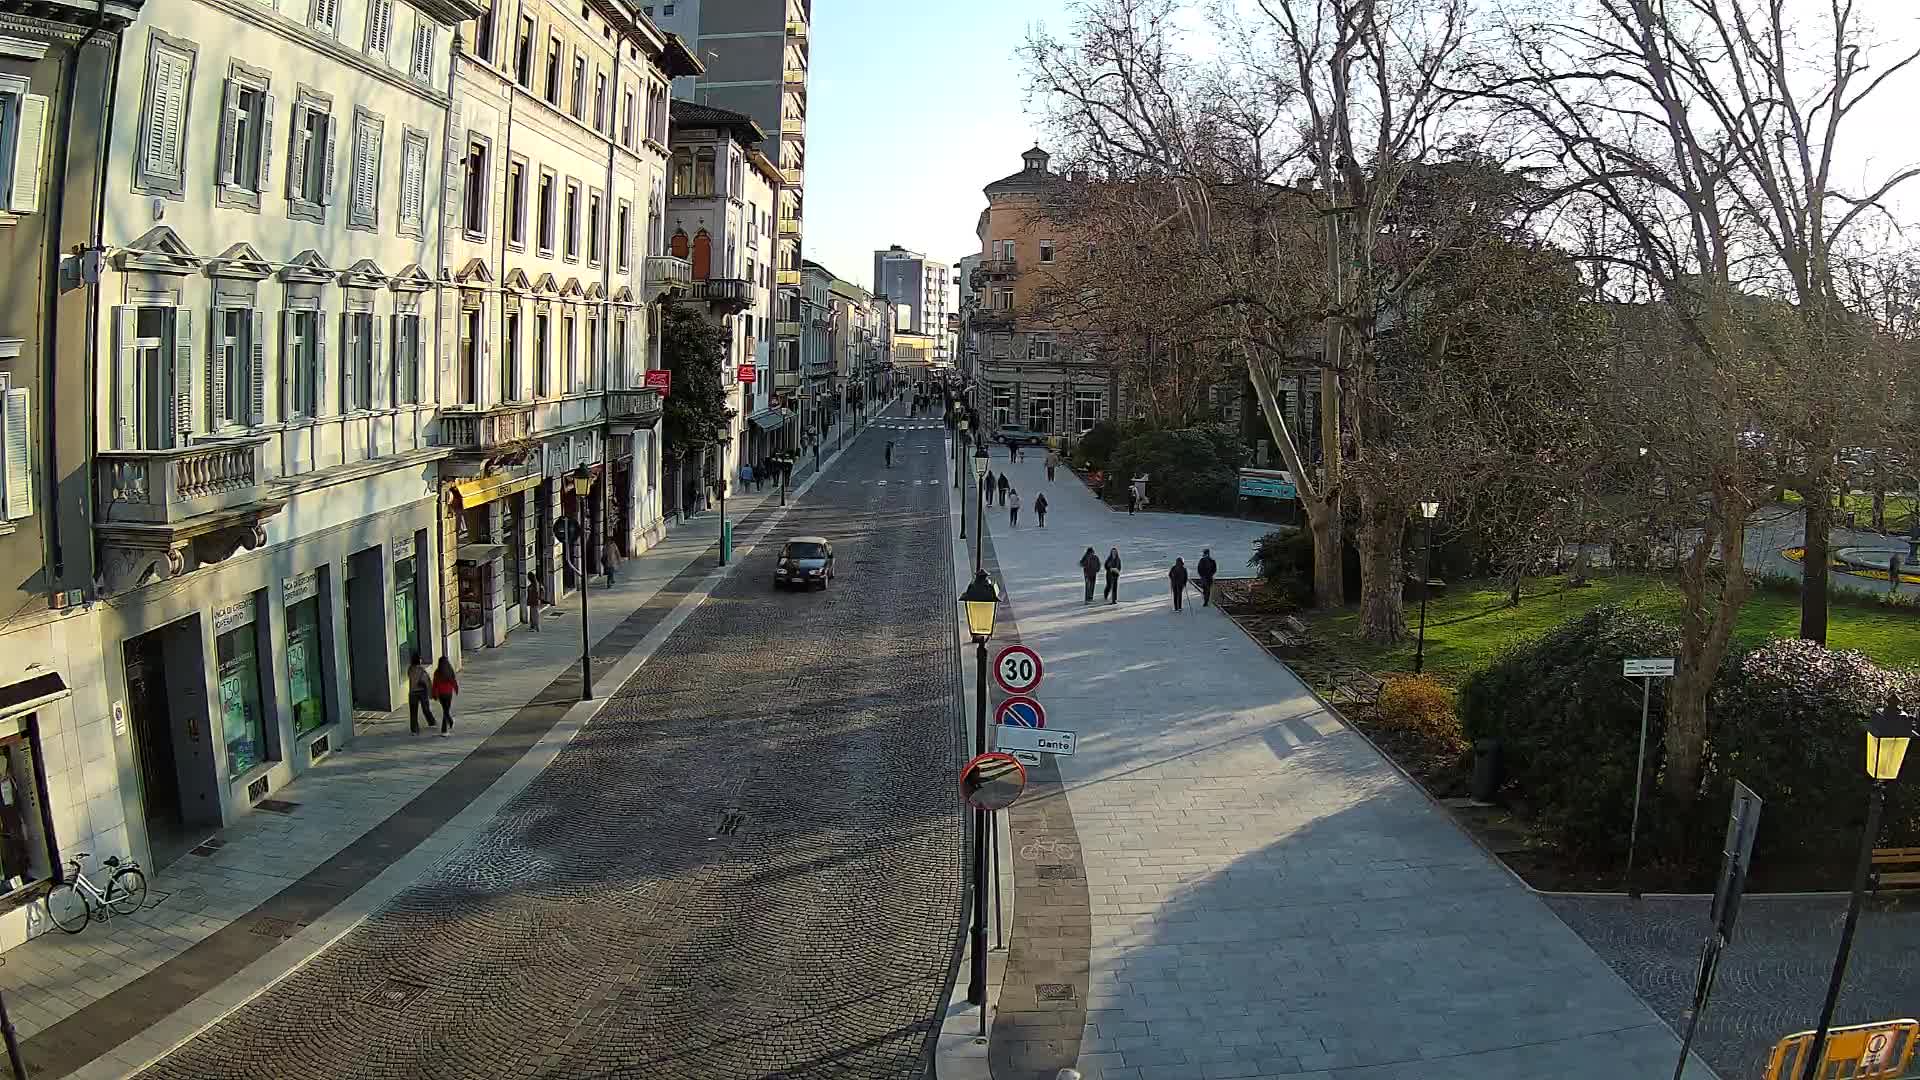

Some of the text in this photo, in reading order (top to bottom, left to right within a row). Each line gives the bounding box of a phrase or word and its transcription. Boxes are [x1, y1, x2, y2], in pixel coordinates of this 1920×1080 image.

[1005, 659, 1032, 681] 30
[221, 678, 240, 701] 130
[1038, 738, 1070, 750] Dante
